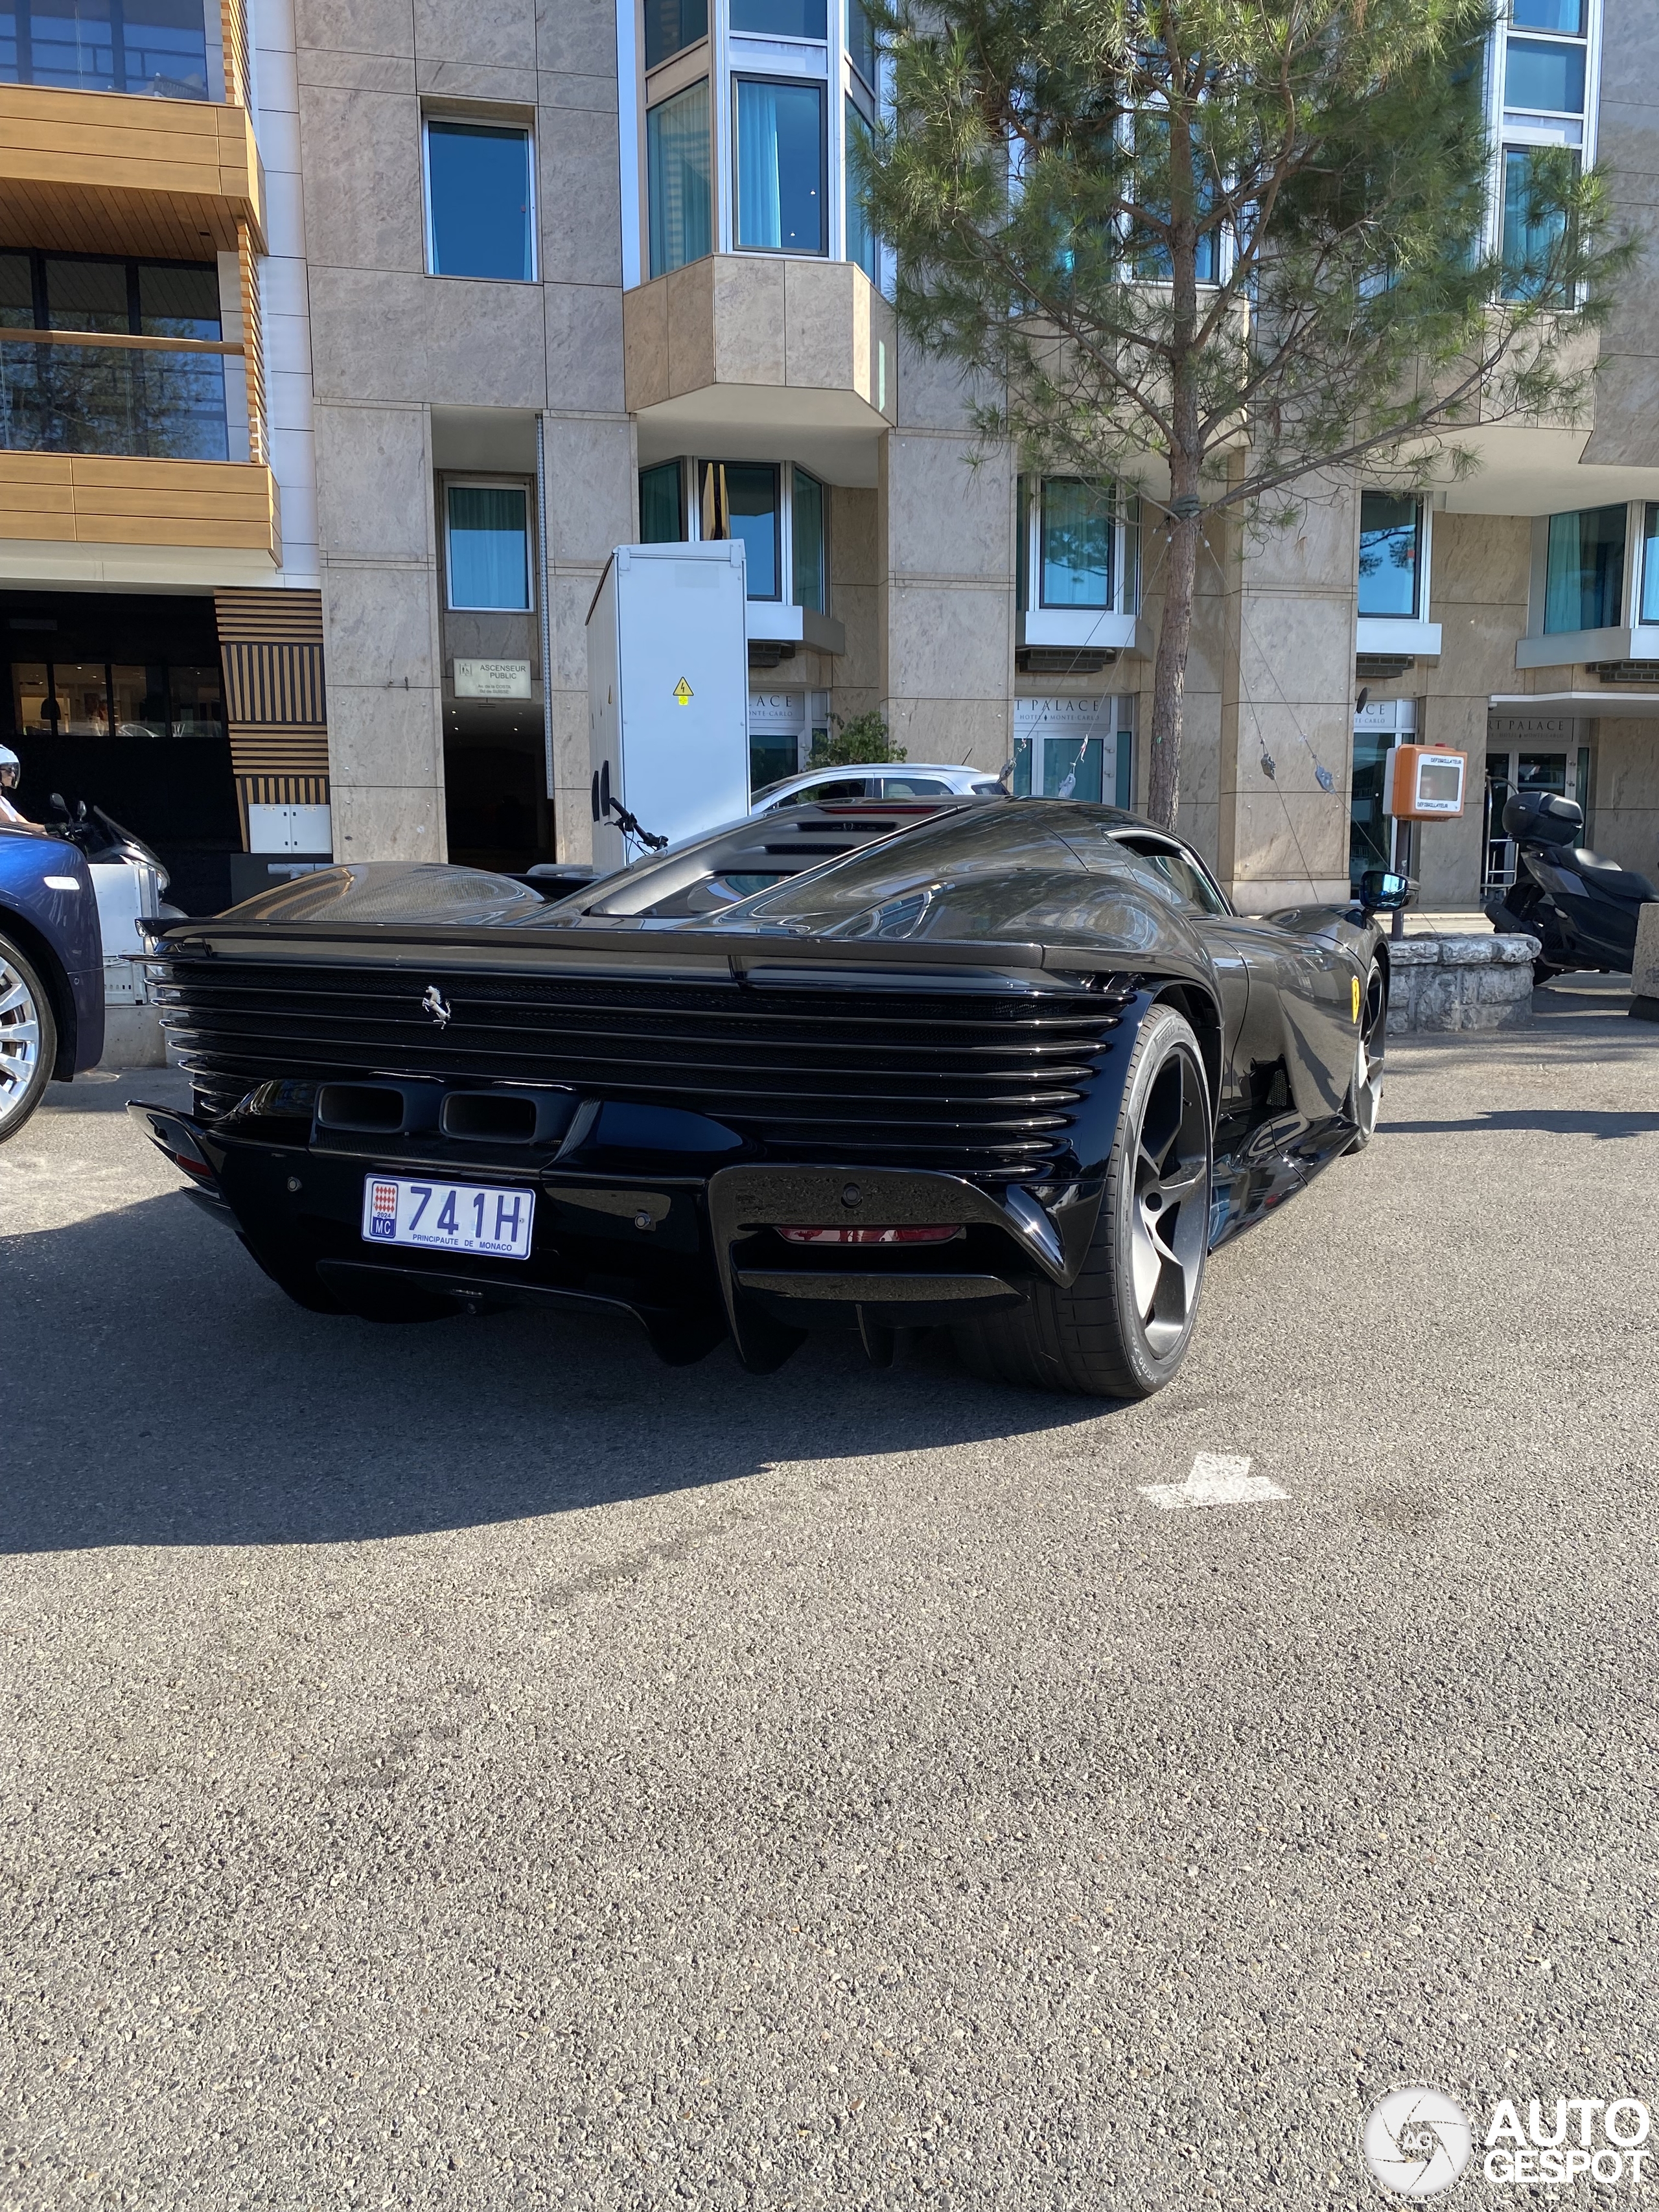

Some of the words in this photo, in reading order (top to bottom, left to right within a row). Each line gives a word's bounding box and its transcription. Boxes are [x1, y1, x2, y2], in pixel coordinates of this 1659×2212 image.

[748, 695, 792, 708] ACE
[1031, 699, 1099, 712] PALACE
[1354, 704, 1385, 715] CE
[1509, 720, 1563, 730] PALACE
[408, 1186, 521, 1242] 741H
[375, 1220, 391, 1235] MC
[412, 1234, 459, 1246] PRINCIPAUTE
[479, 1242, 513, 1252] MONACO
